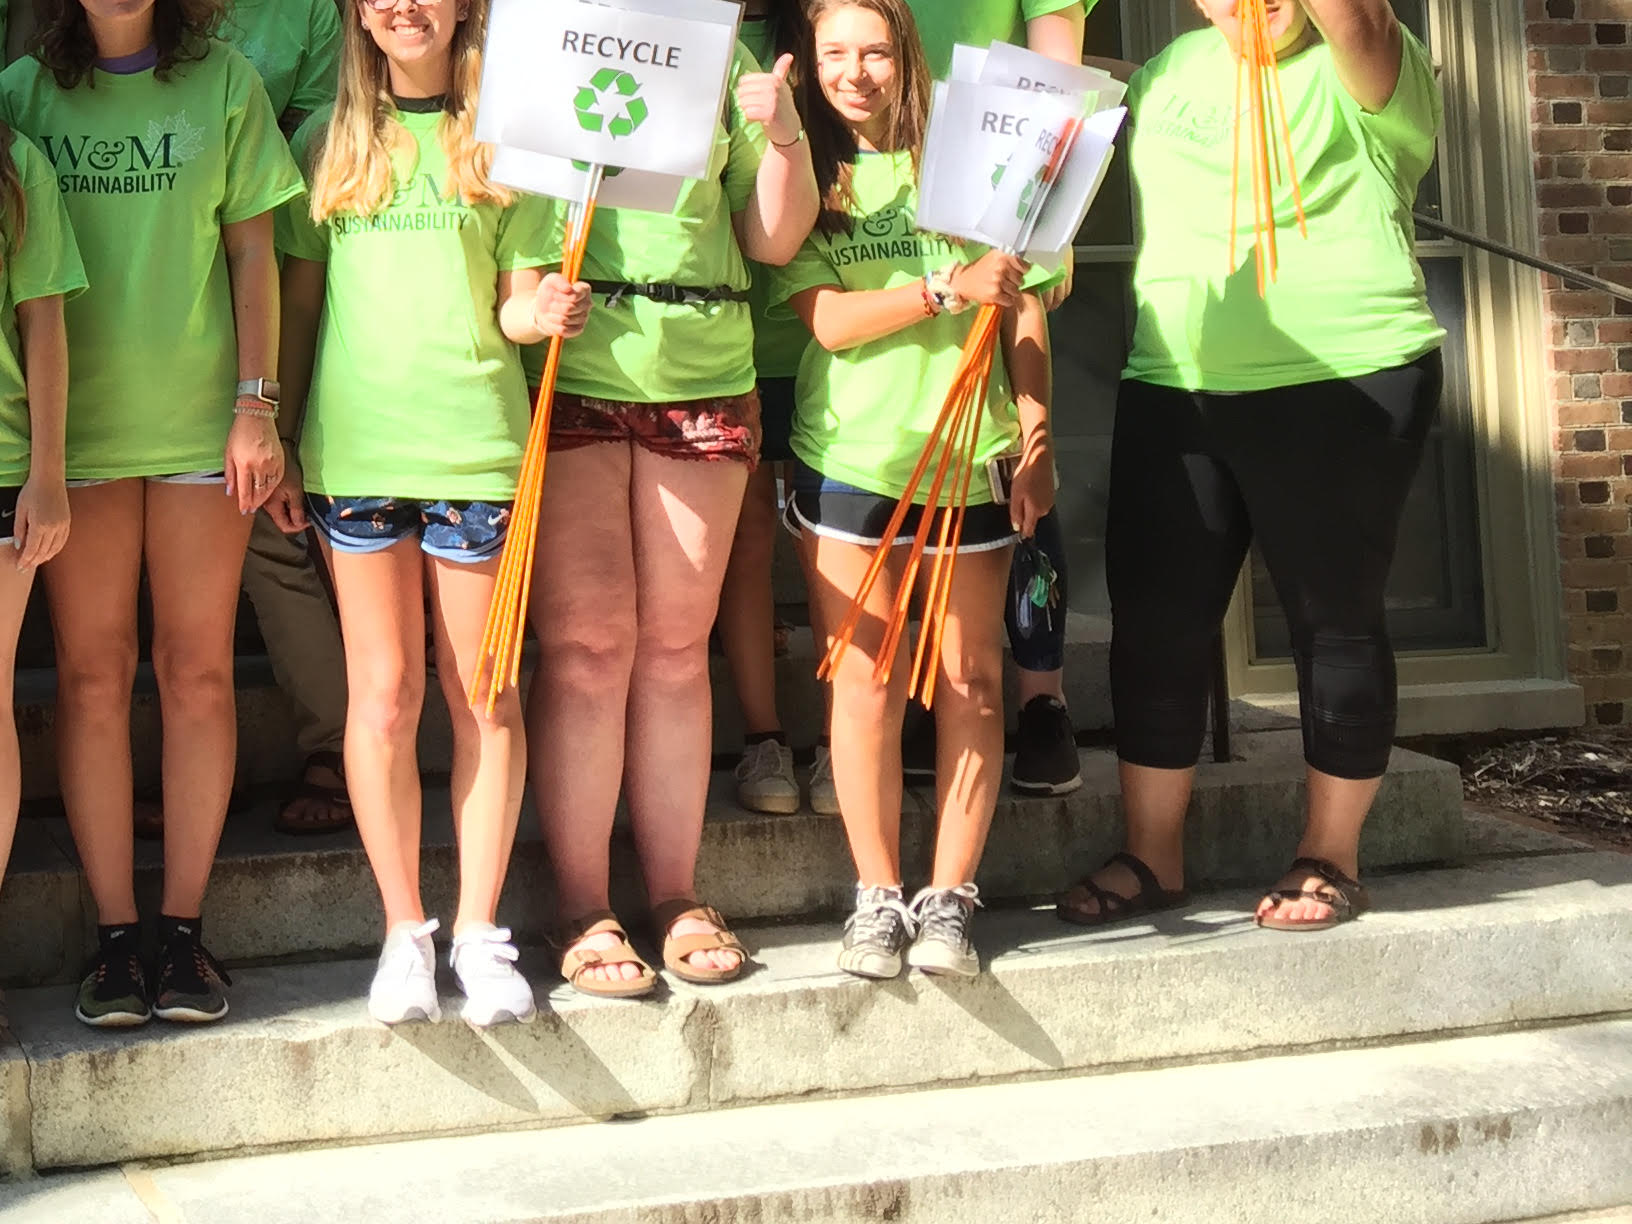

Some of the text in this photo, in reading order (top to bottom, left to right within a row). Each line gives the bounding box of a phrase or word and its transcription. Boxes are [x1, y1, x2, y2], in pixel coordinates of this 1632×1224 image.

[562, 30, 682, 69] RECYCLE
[57, 173, 177, 194] STAINABILITY
[827, 237, 953, 267] USTAINABILITY
